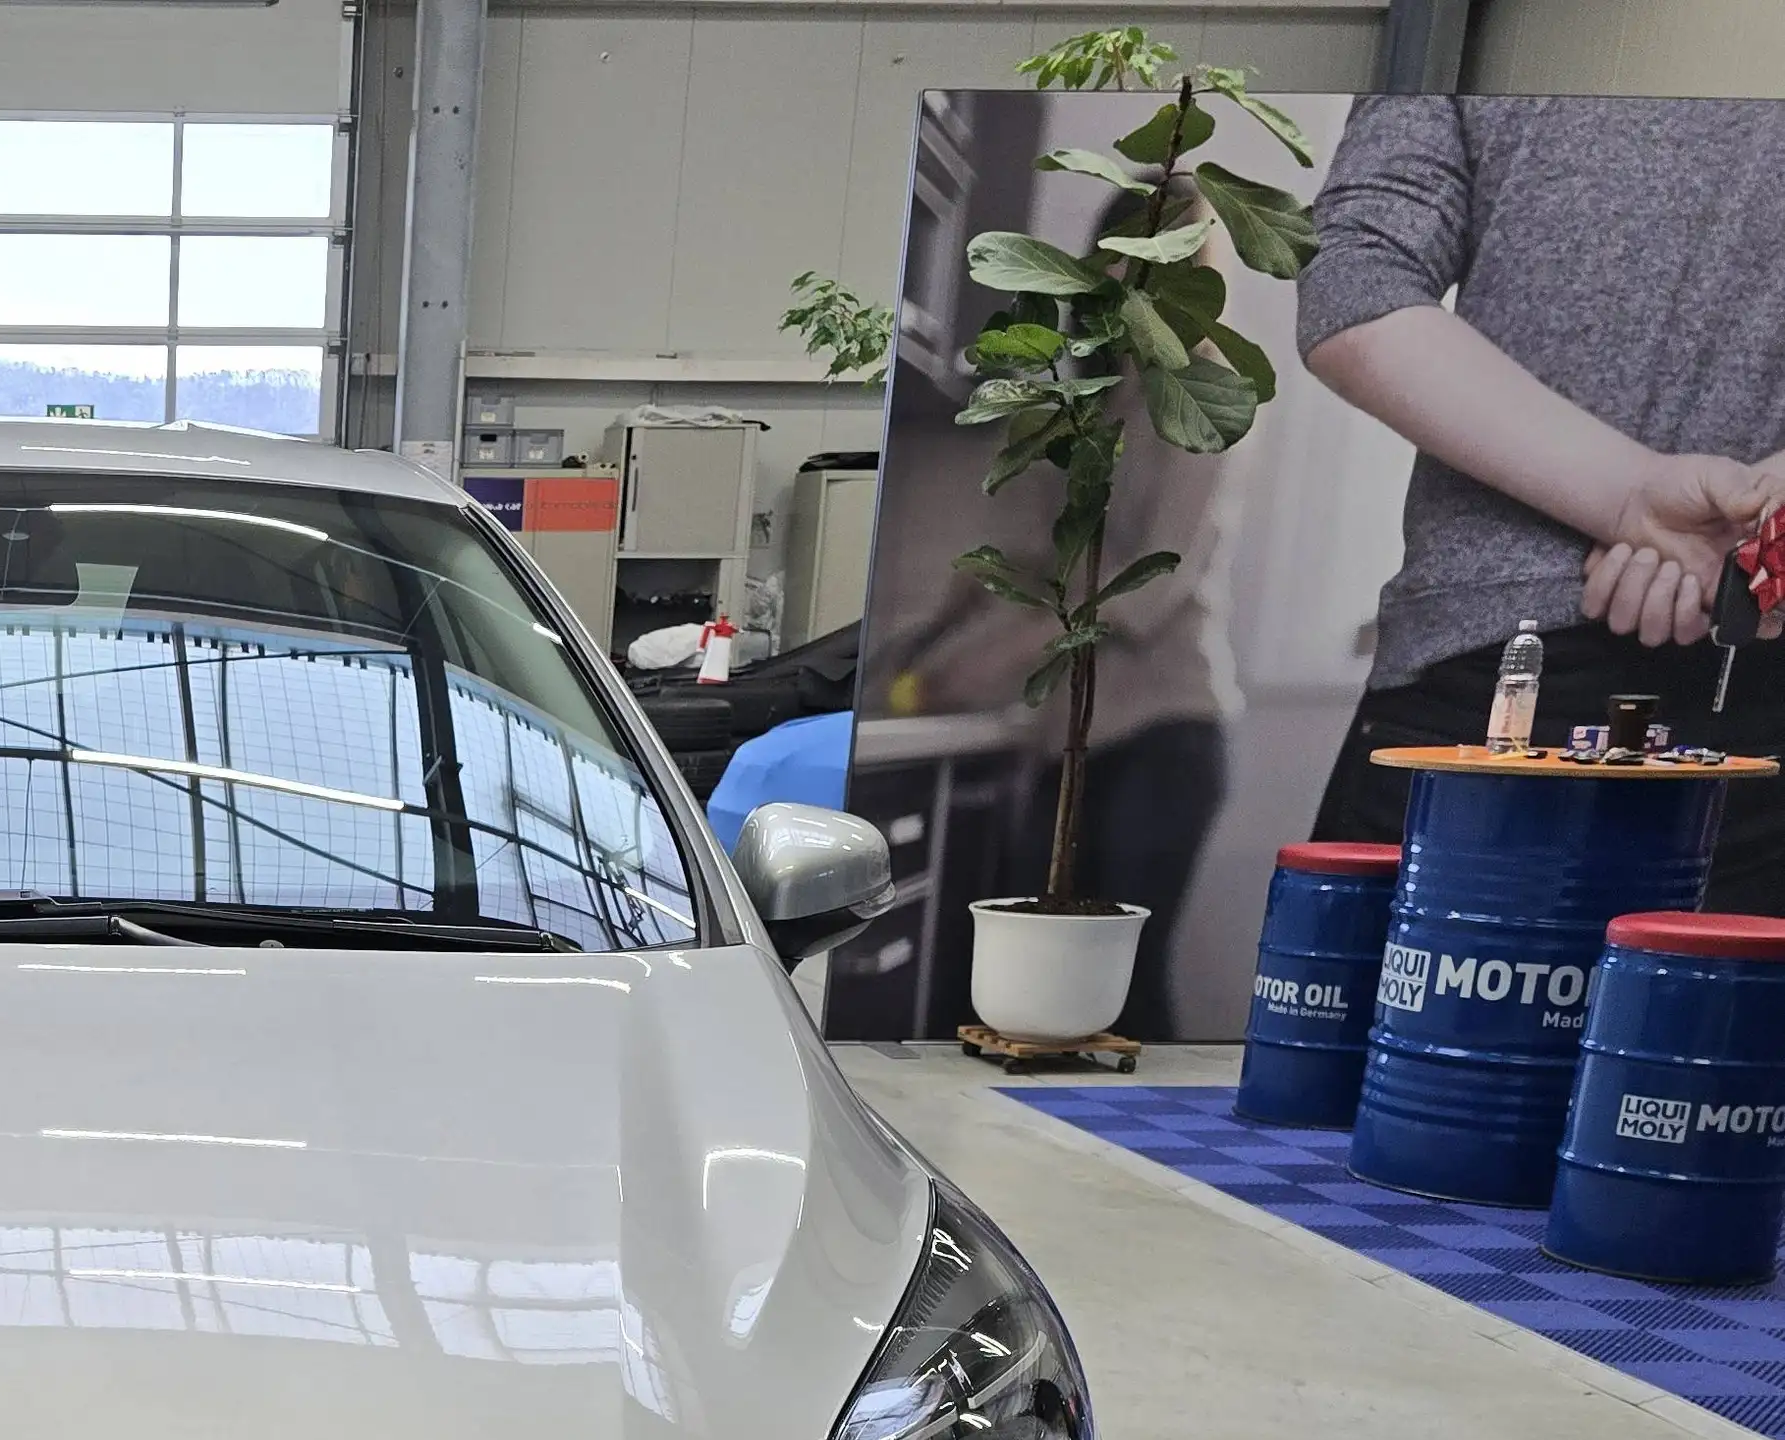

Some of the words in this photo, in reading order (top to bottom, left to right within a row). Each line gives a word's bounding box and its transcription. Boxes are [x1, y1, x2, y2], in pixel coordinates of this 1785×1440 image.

[1304, 983, 1349, 1009] OIL
[1542, 1010, 1585, 1029] Mad
[1624, 1097, 1688, 1121] LIQUI
[1620, 1117, 1684, 1141] MOLY
